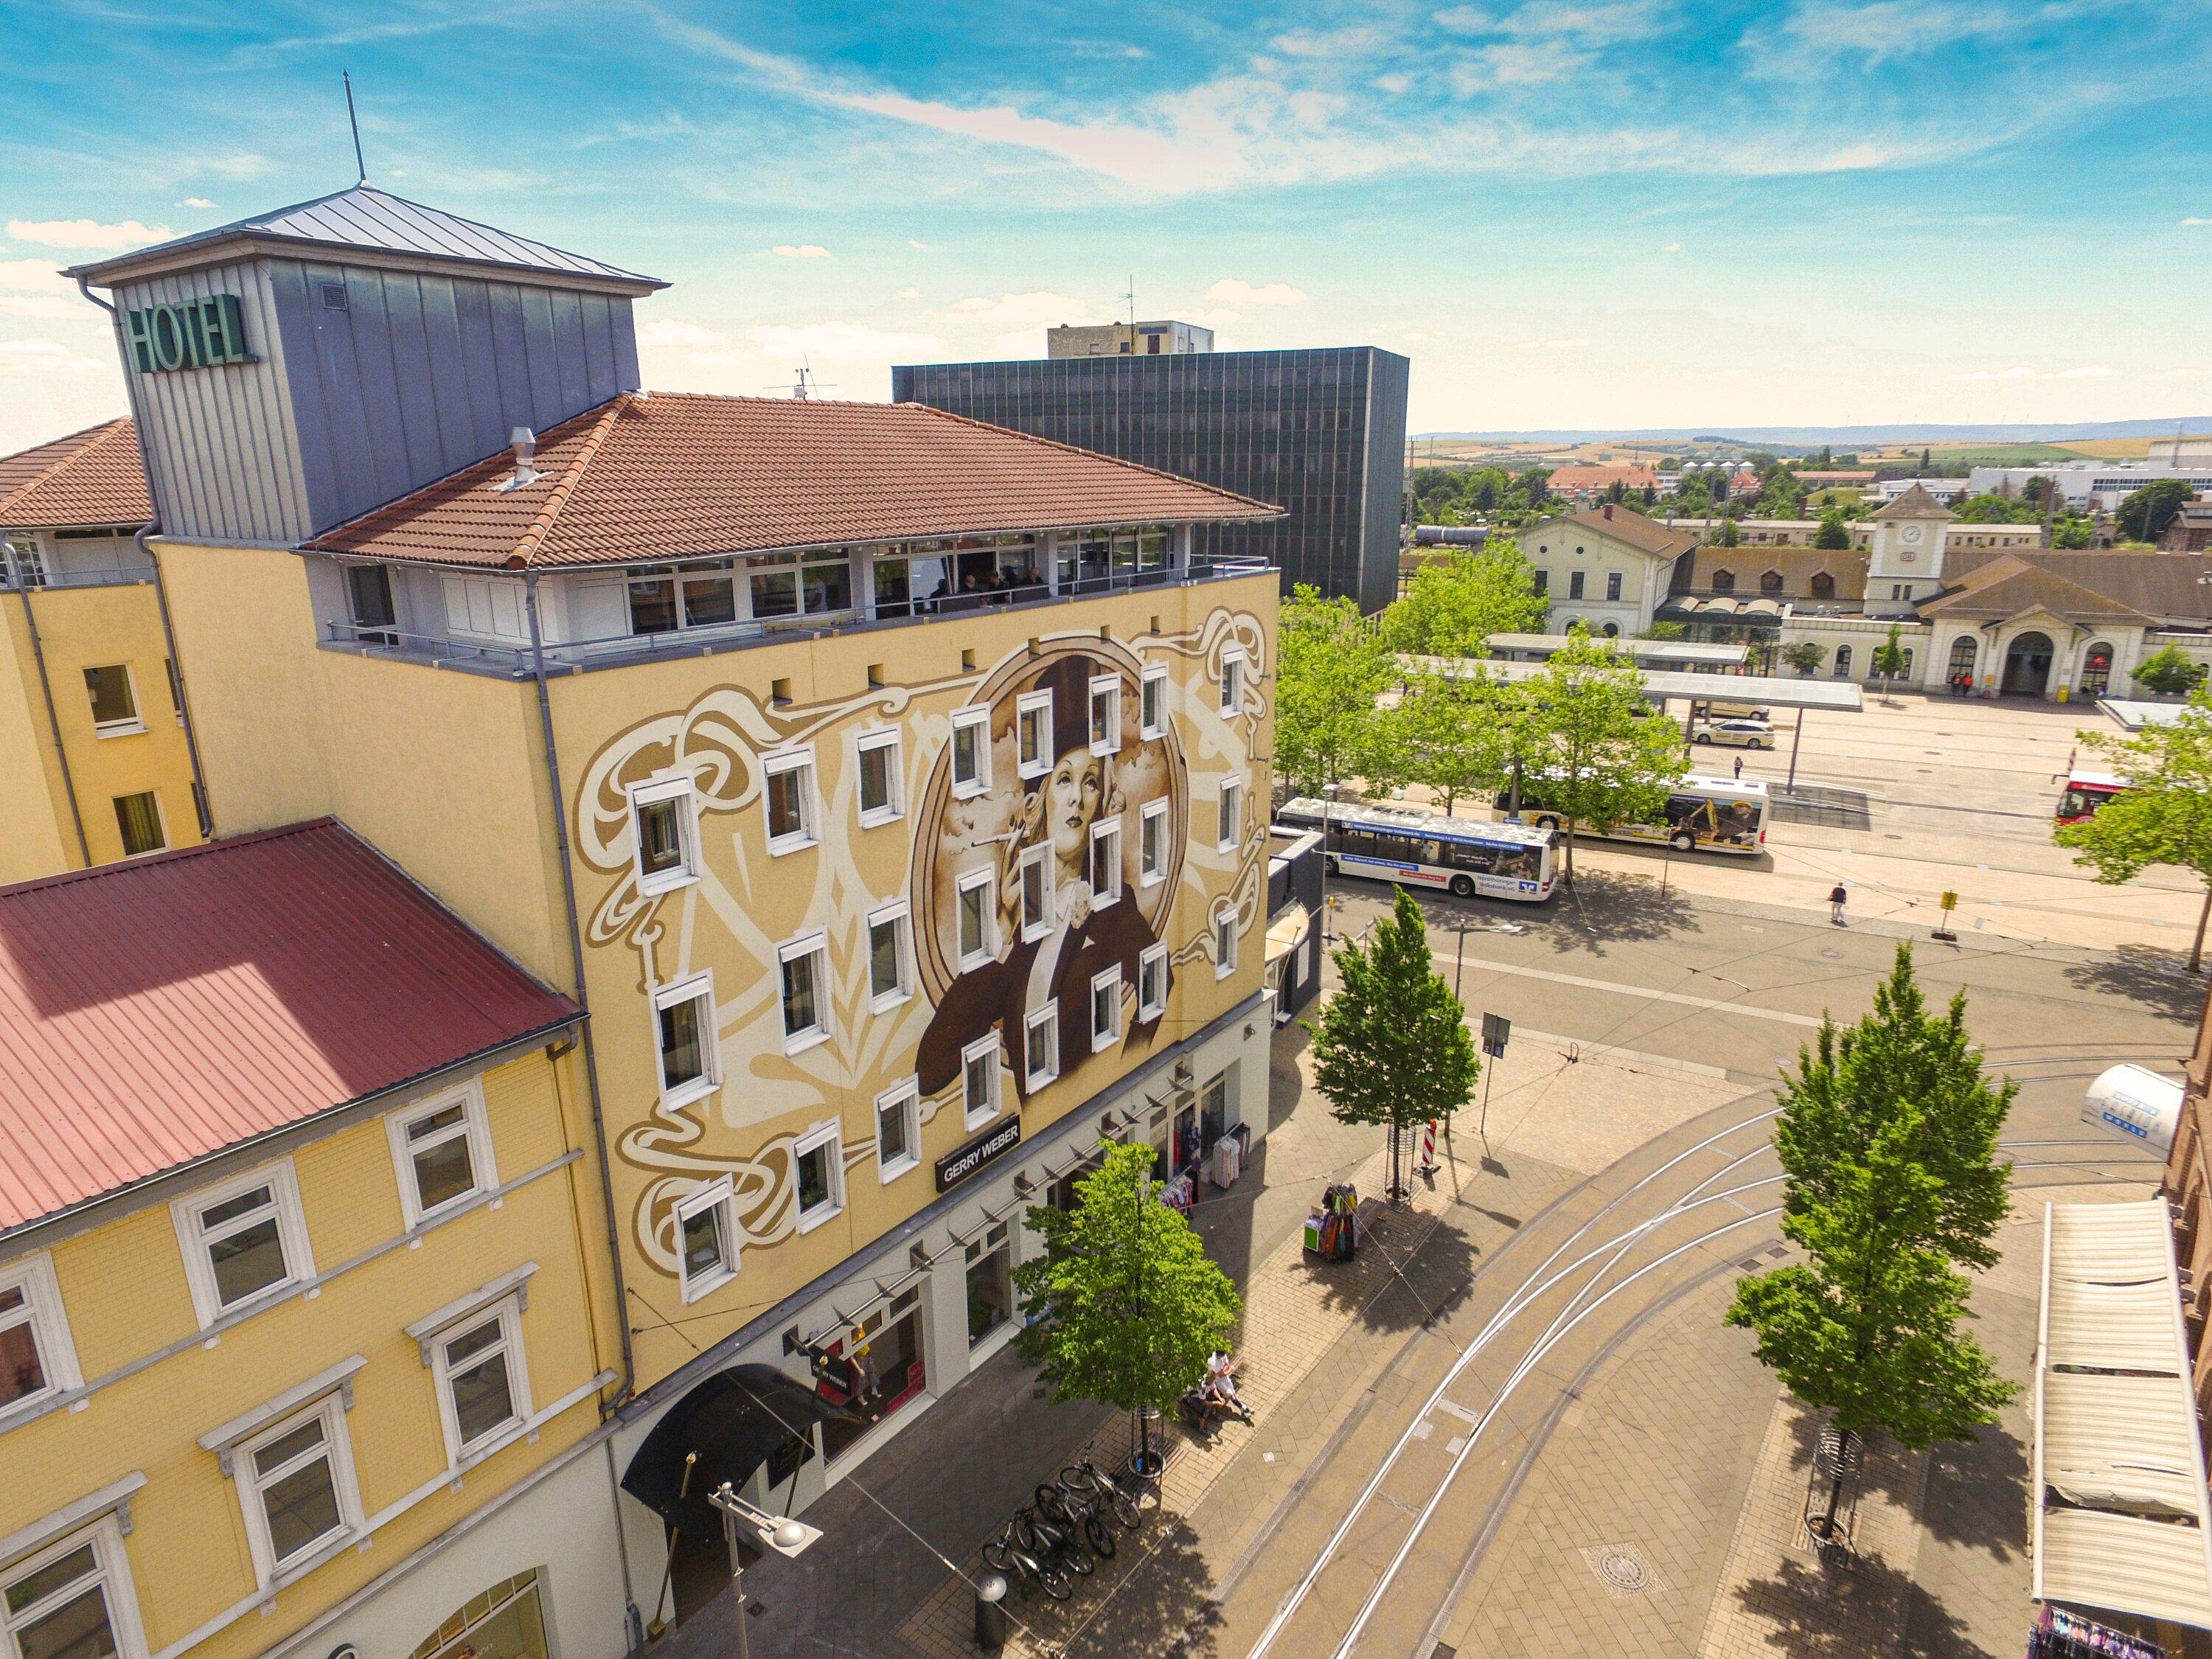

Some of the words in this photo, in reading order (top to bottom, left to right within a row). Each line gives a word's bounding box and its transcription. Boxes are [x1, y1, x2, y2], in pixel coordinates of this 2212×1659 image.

[125, 293, 251, 373] HOTEL
[1480, 881, 1506, 890] Volksbank
[944, 1148, 981, 1182] GERRY
[981, 1125, 1019, 1158] WEBER
